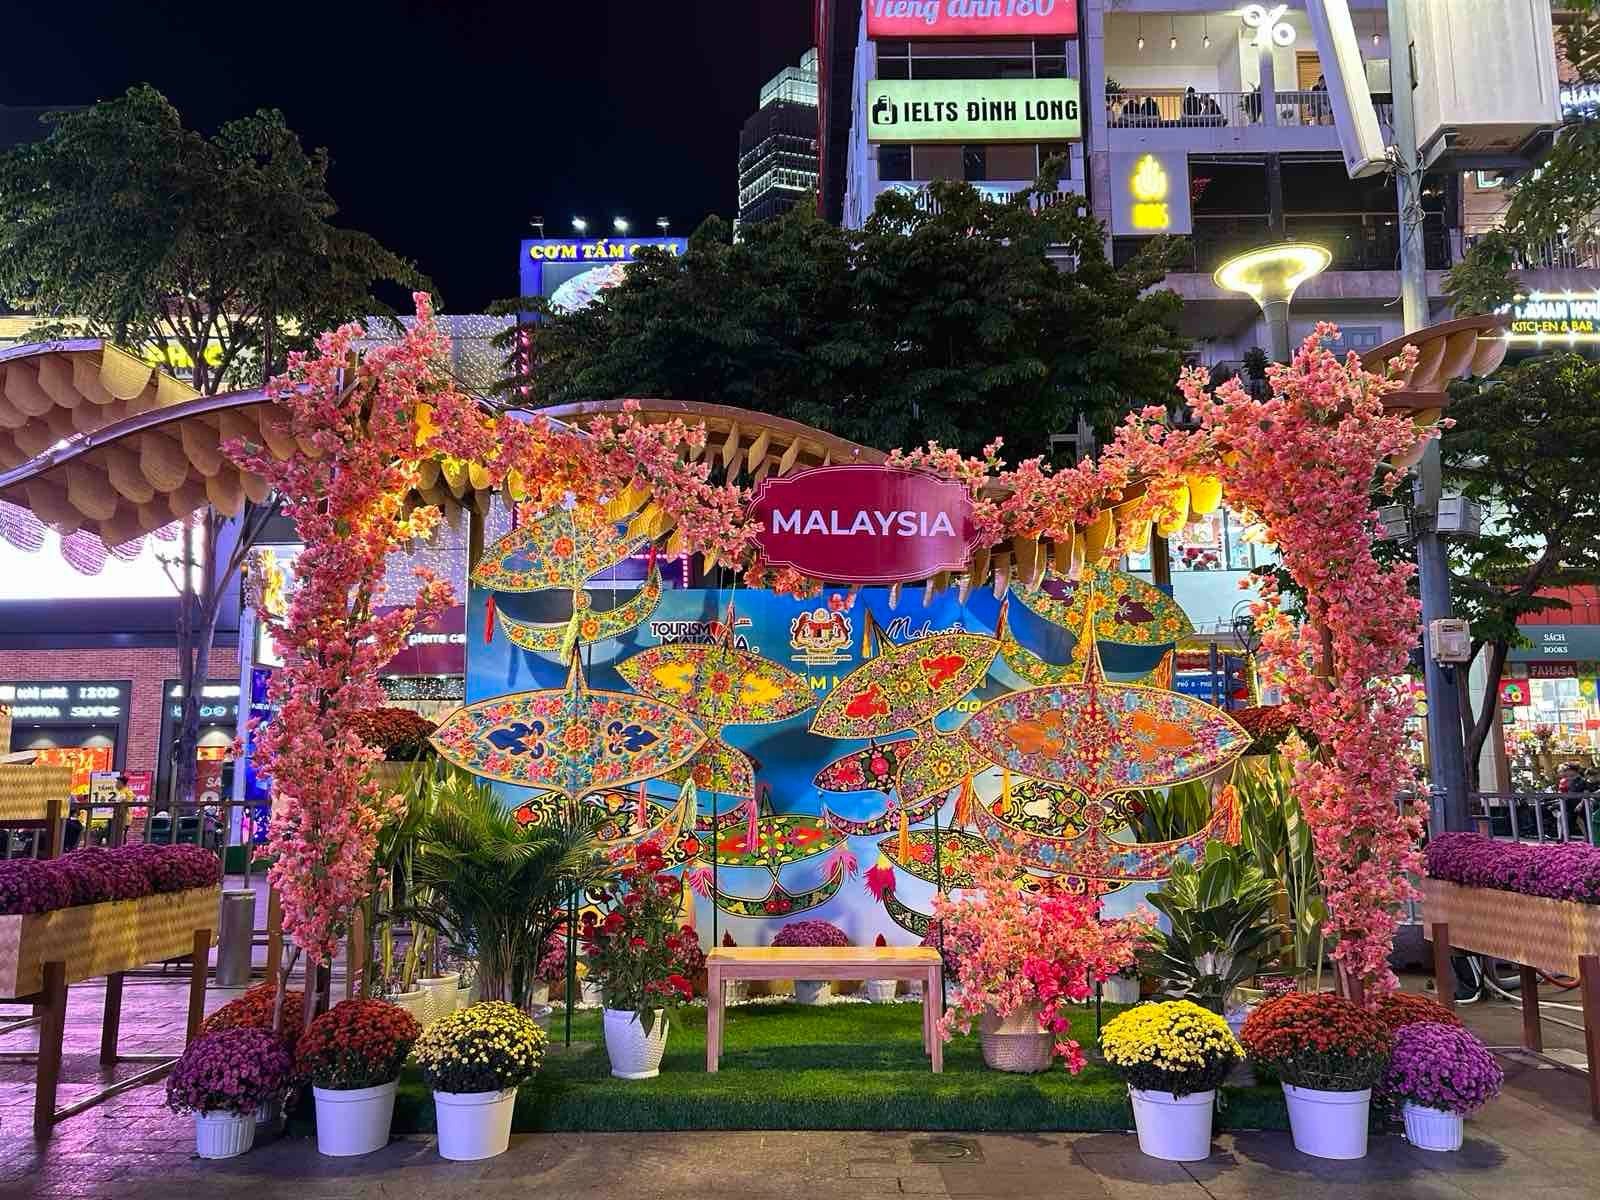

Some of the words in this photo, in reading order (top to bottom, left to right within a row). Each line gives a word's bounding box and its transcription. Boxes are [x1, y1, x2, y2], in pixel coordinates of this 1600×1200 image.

[904, 102, 959, 122] IELTS
[1025, 100, 1079, 120] LONG
[530, 244, 577, 260] CƠM
[581, 238, 625, 259] TẤM
[1571, 321, 1593, 332] BAR
[771, 509, 956, 537] MALAYSIA
[651, 622, 711, 636] TOURISM
[1543, 632, 1565, 641] SÁCH
[1531, 665, 1576, 675] FAHASA
